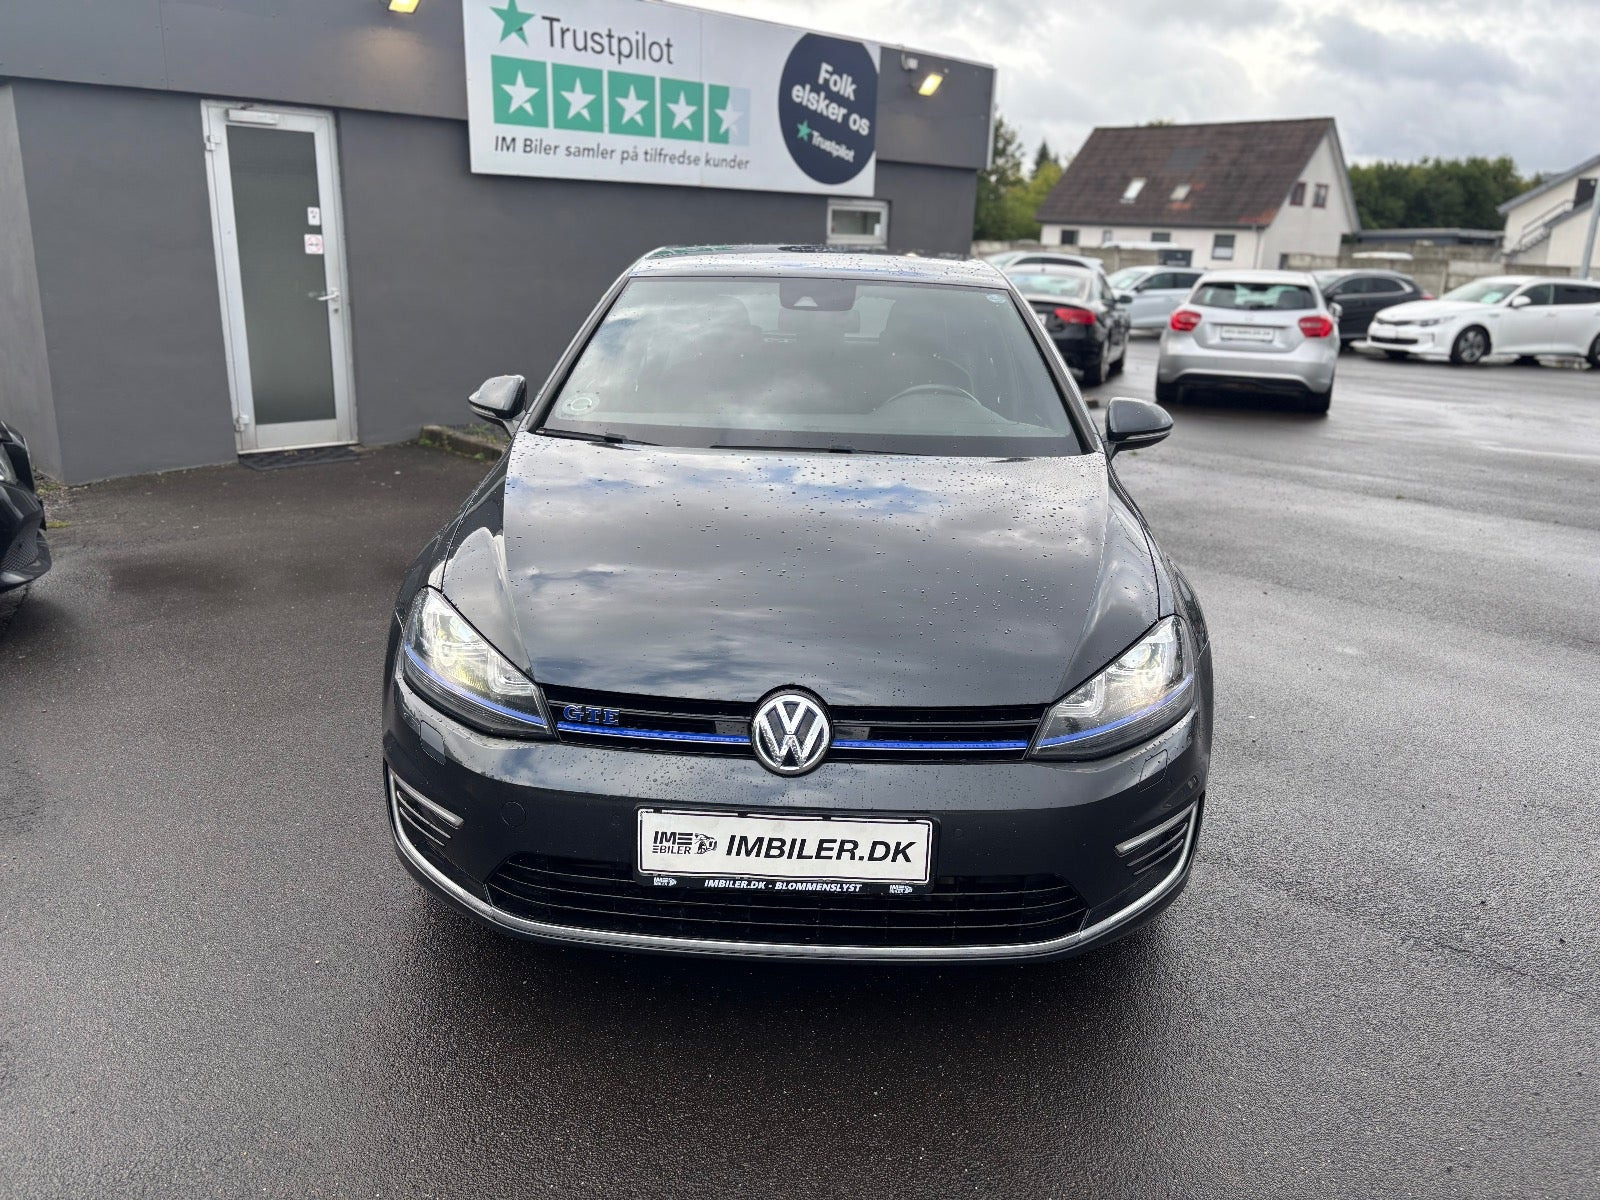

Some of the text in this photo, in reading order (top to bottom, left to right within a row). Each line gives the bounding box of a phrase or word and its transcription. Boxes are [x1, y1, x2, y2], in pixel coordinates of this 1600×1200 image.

[542, 15, 675, 66] Trustpilot
[818, 62, 857, 101] Folk
[791, 84, 871, 136] elsker os
[494, 135, 750, 171] IM Biler samler på tilfredse kunder
[811, 129, 855, 163] Trustpilot
[563, 704, 620, 726] GTE
[725, 834, 918, 863] IMBILER.DK
[704, 879, 766, 890] IMBILER.DK
[774, 881, 863, 893] BLOMMENSLYST
